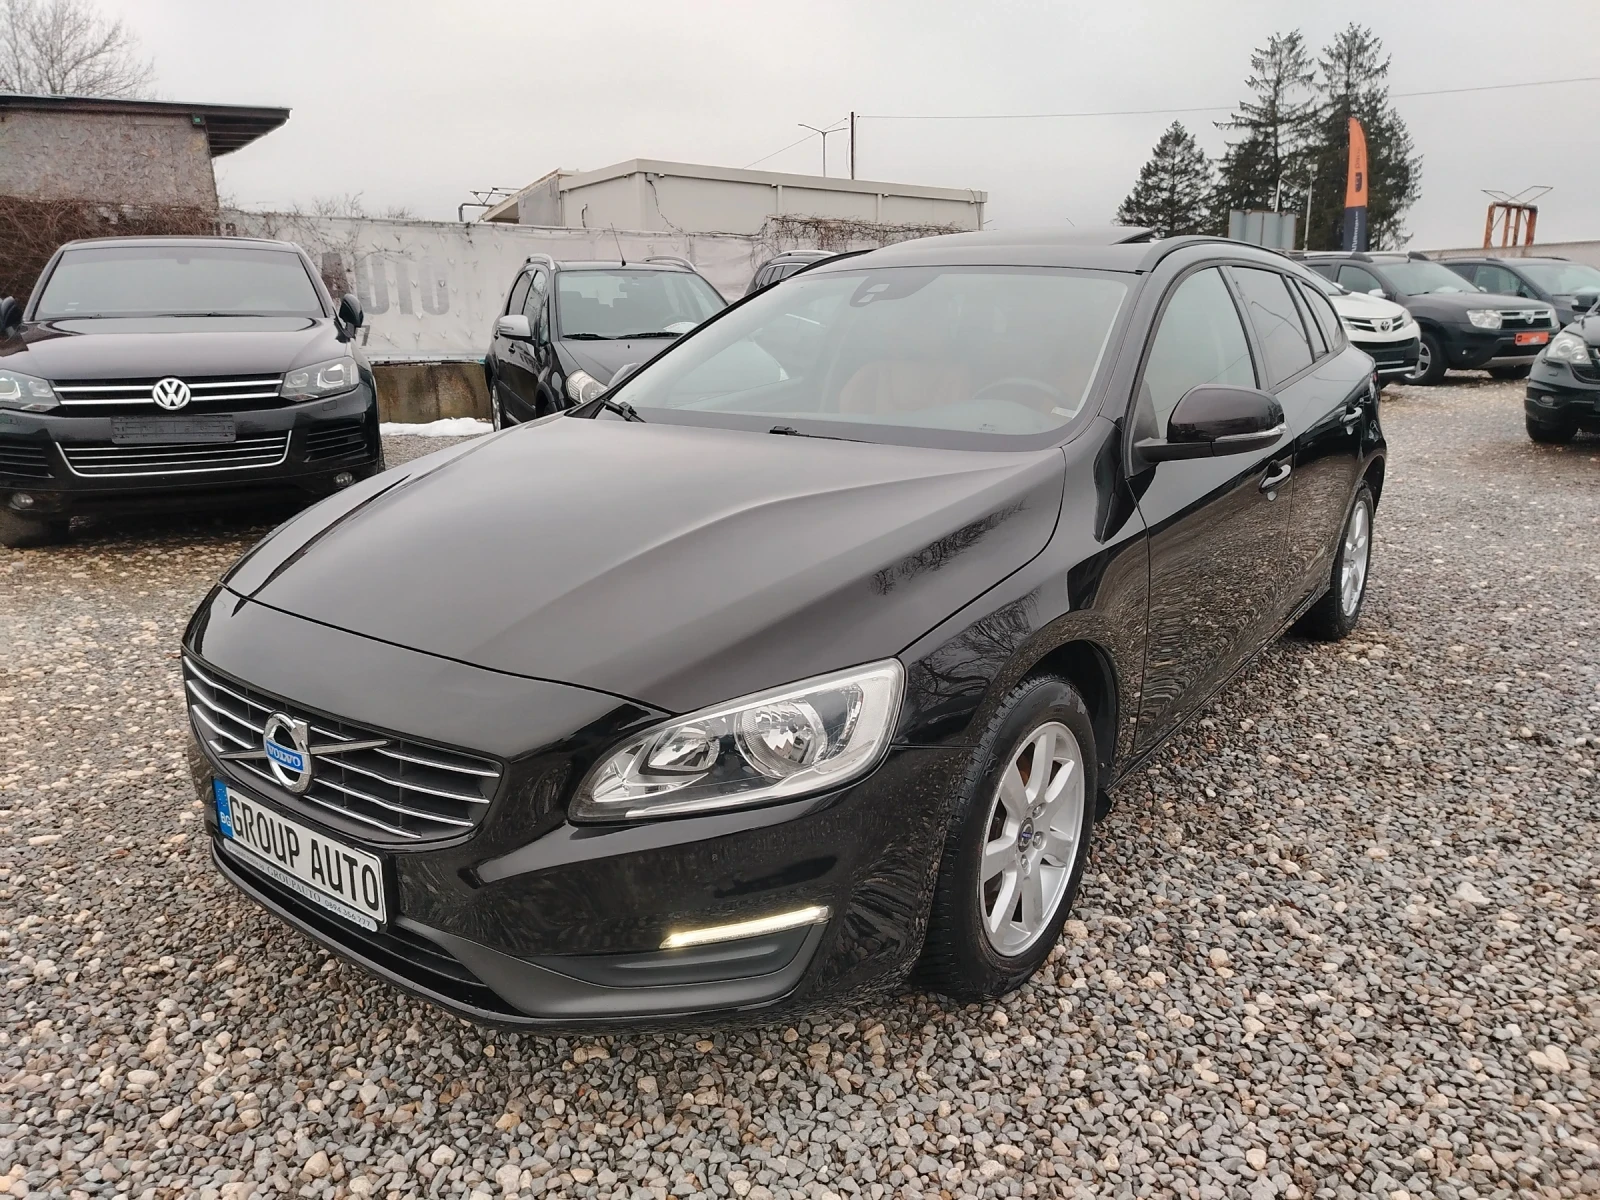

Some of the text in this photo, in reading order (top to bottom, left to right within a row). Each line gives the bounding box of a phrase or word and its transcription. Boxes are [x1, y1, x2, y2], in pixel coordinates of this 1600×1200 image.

[267, 744, 301, 767] VOLVO
[220, 811, 232, 827] BG
[229, 795, 379, 911] GROUP AUTO
